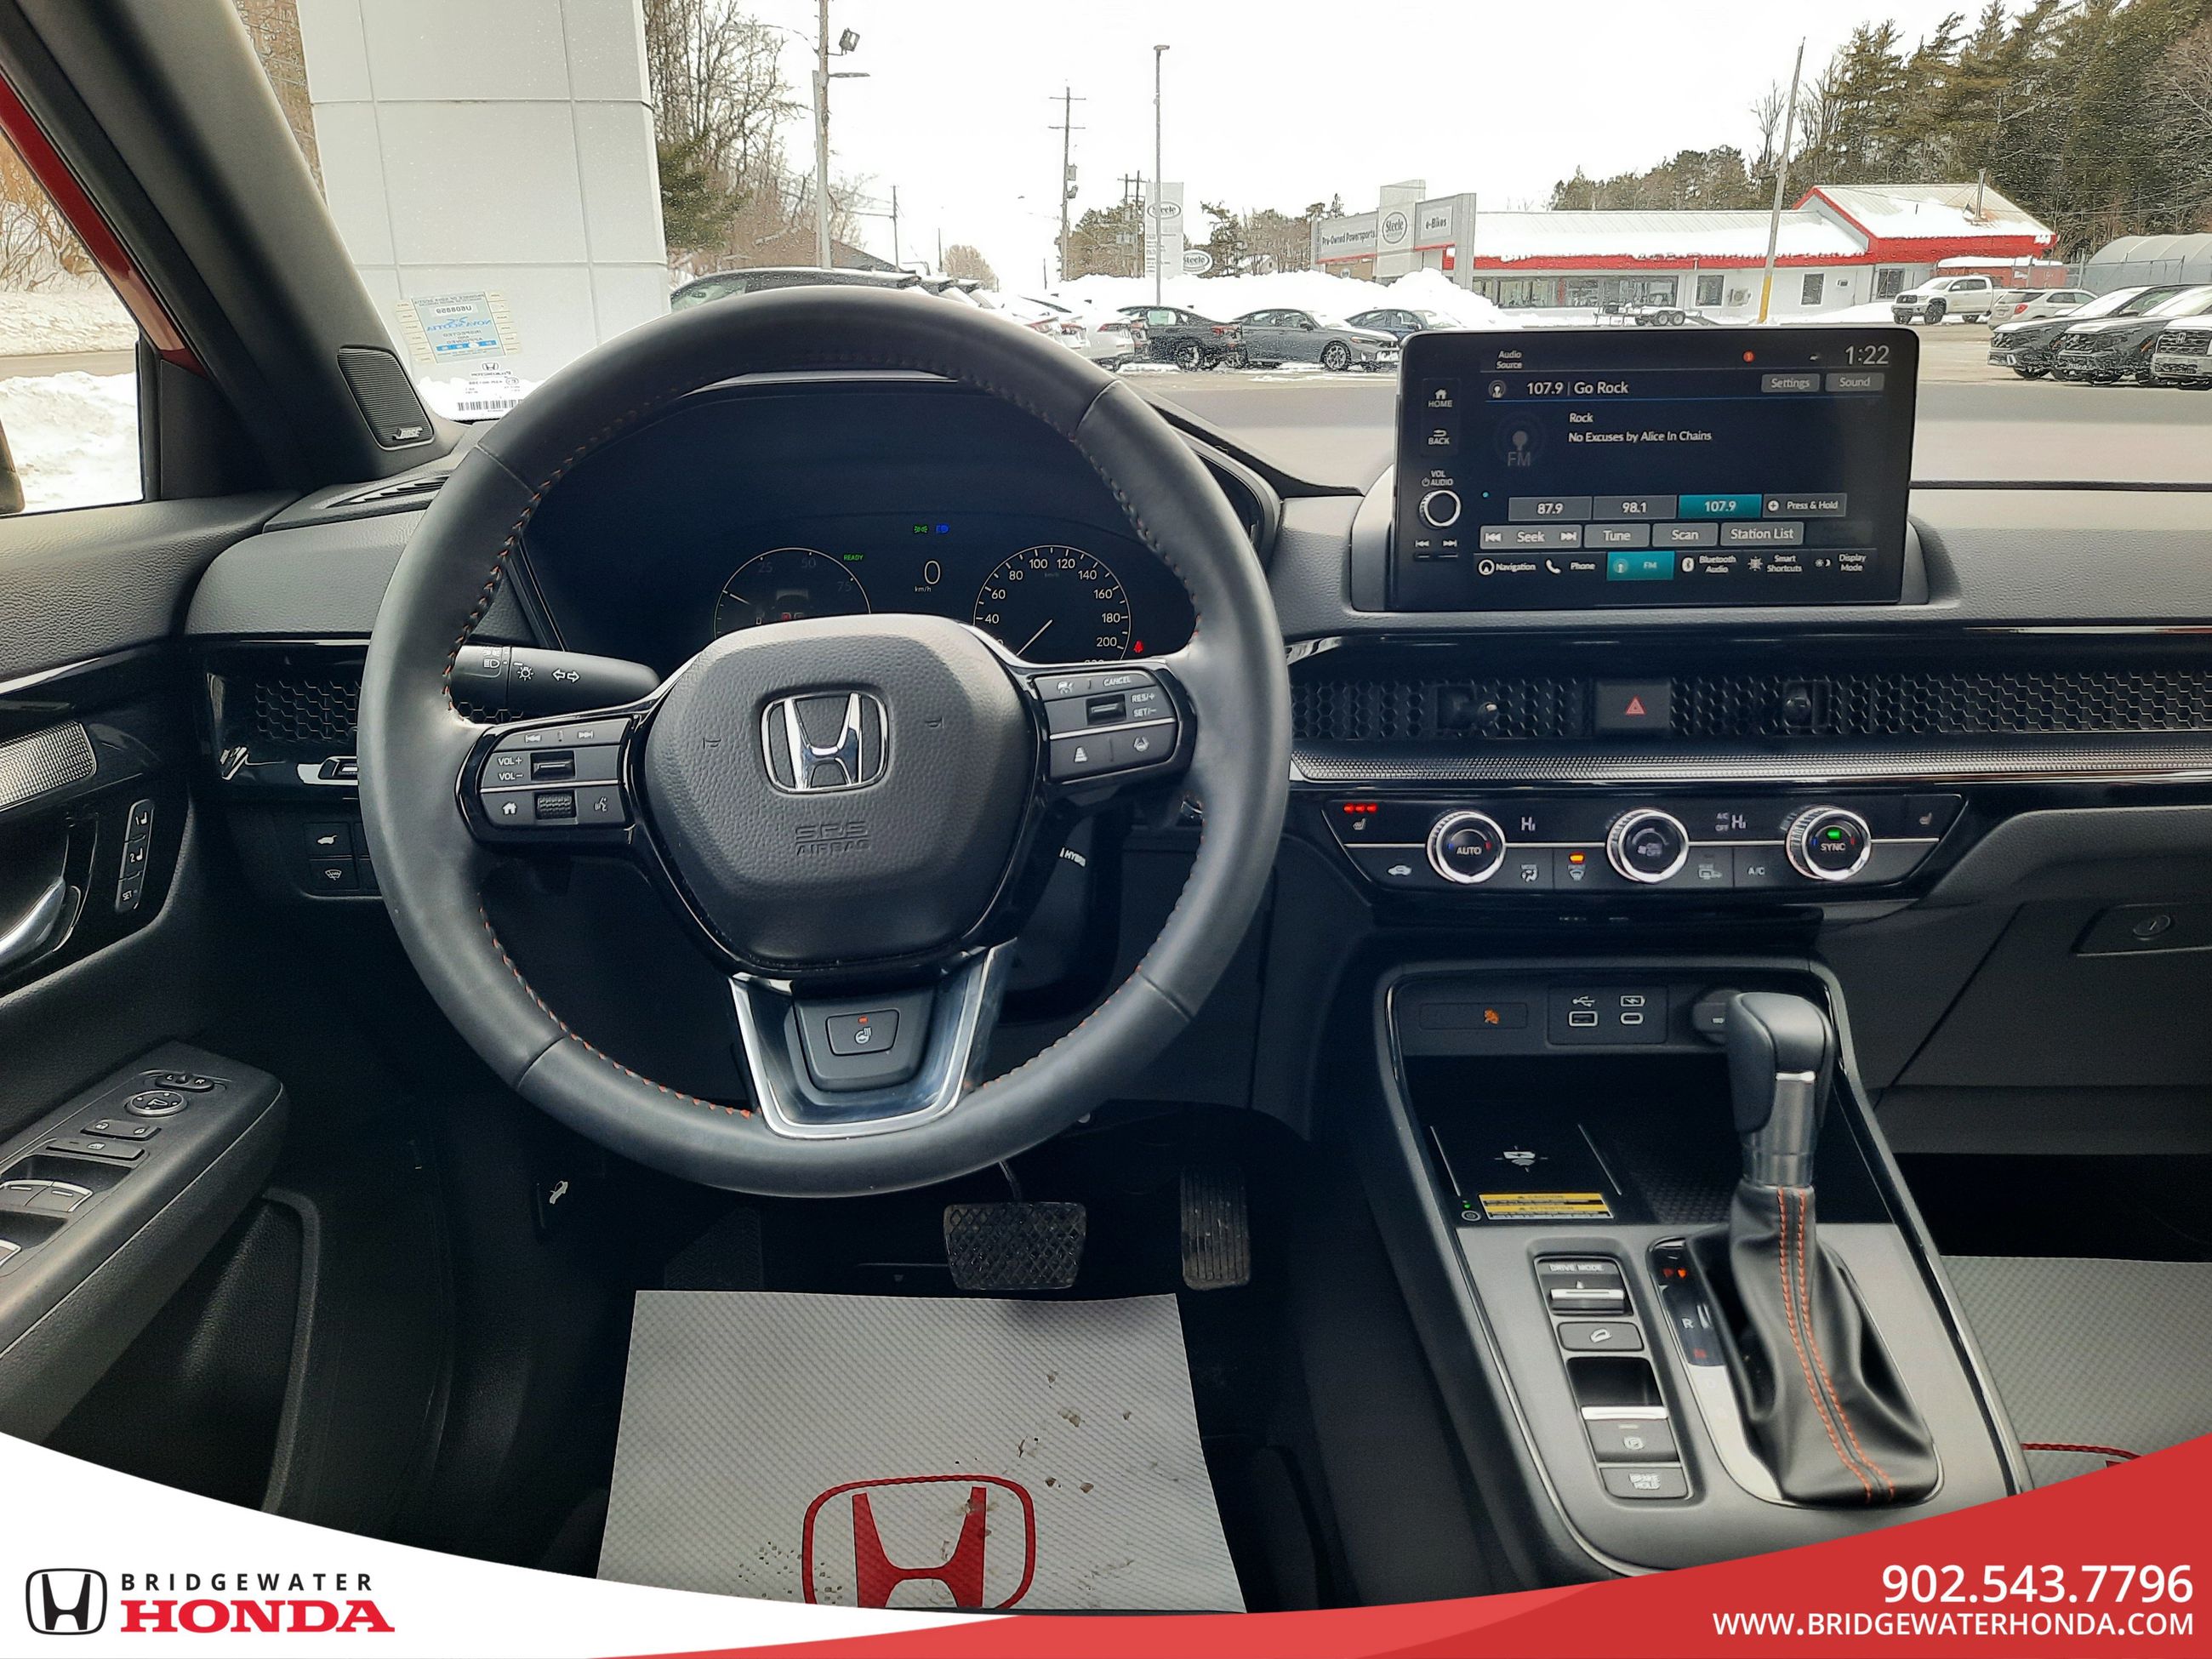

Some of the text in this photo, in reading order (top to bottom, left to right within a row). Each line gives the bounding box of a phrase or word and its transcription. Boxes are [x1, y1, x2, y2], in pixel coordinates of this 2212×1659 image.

[1386, 219, 1404, 233] Steele
[1425, 217, 1447, 230] e-Bikes
[1322, 232, 1345, 246] Pre-Owned
[1498, 350, 1523, 359] Audio
[1844, 345, 1890, 366] 1:22
[1496, 361, 1523, 369] Source
[1574, 380, 1629, 395] Go Rock
[1770, 378, 1810, 391] Settings
[1839, 377, 1871, 388] Sound
[1526, 382, 1565, 396] 107.9
[1428, 400, 1453, 408] HOME
[1569, 413, 1593, 424] Rock
[1428, 437, 1451, 446] BACK
[1568, 430, 1713, 445] No Excuses by Alice In Chains
[1507, 452, 1531, 467] FM
[1430, 470, 1446, 478] VOL
[1430, 478, 1454, 487] AUDIO
[1536, 503, 1564, 515] 87.9
[1622, 502, 1648, 514] 98.1
[1703, 500, 1737, 513] 107.9
[1787, 500, 1839, 510] Press & Hold
[1516, 531, 1546, 544] Seek
[1603, 530, 1632, 542] Tune
[1671, 529, 1700, 541] Scan
[1730, 527, 1795, 540] Station List
[1029, 559, 1048, 569] 100
[1057, 559, 1076, 569] 120
[1698, 555, 1737, 564] Bluetooth
[1774, 555, 1797, 564] Smart
[1839, 553, 1867, 565] Display
[1495, 562, 1536, 573] Navigation
[1570, 561, 1596, 571] Phone
[1643, 561, 1658, 570] FM
[1705, 564, 1729, 573] Audio
[1766, 564, 1803, 573] Shortcuts
[1840, 563, 1863, 573] Mode
[924, 560, 941, 585] 0
[1008, 570, 1023, 581] 80
[1077, 570, 1097, 580] 140
[990, 589, 1006, 600] 60
[1093, 589, 1113, 600] 160
[984, 613, 1000, 624] 40
[1101, 613, 1120, 624] 180
[1096, 636, 1117, 647] 200
[1103, 676, 1132, 687] CANCEL
[1456, 845, 1482, 856] AUTO
[1820, 841, 1846, 852] SYNC
[129, 852, 136, 864] 2
[1747, 866, 1765, 876] A/C
[122, 889, 133, 902] SET
[1548, 1263, 1605, 1272] DRIVE MODE
[1681, 1317, 1694, 1329] R
